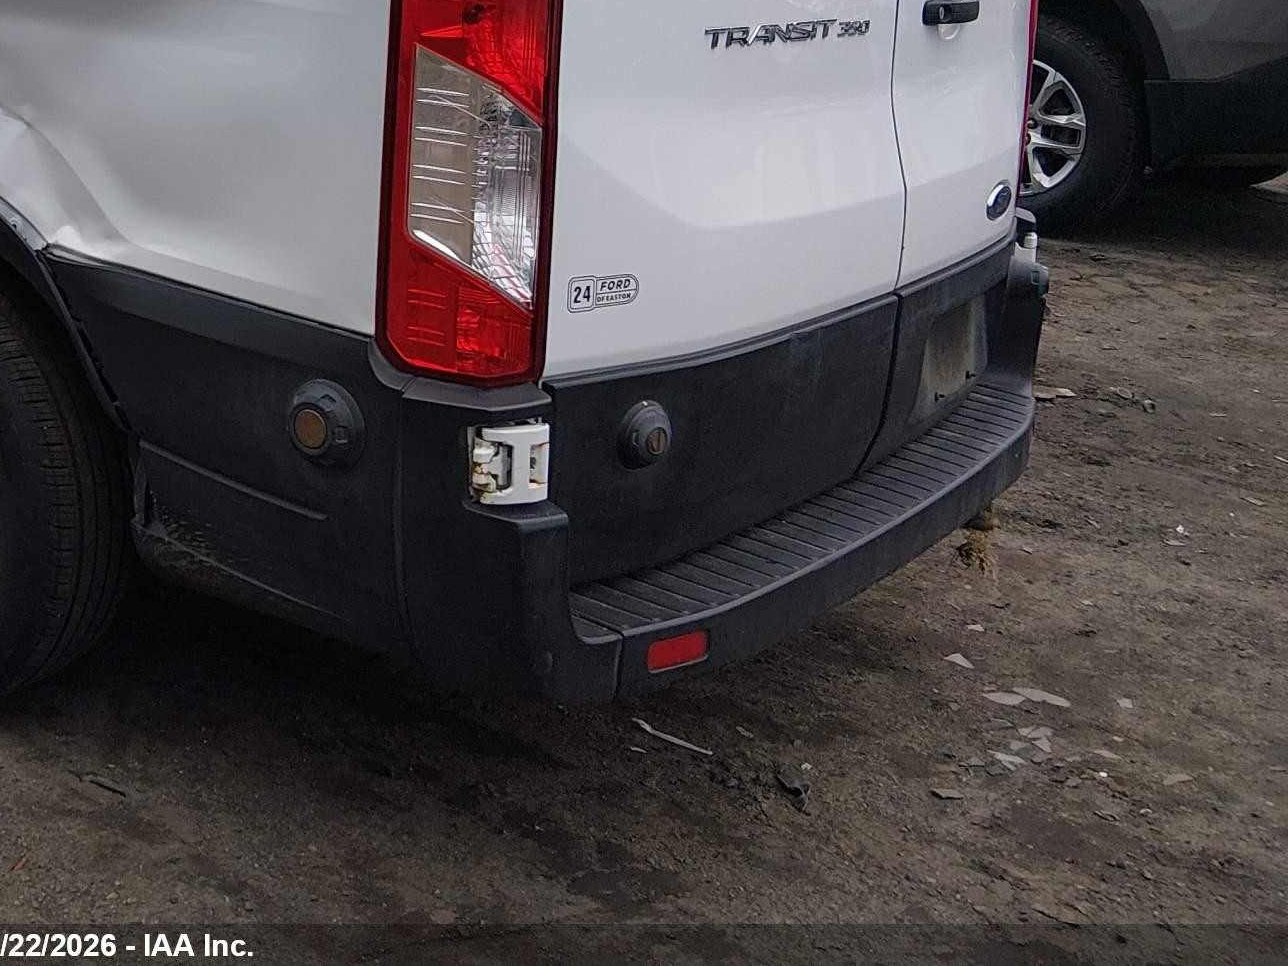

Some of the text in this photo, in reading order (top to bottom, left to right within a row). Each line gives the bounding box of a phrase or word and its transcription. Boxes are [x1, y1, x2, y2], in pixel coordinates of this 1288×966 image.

[704, 18, 838, 50] TRANSIT
[573, 285, 591, 304] 24
[599, 278, 631, 292] FORD
